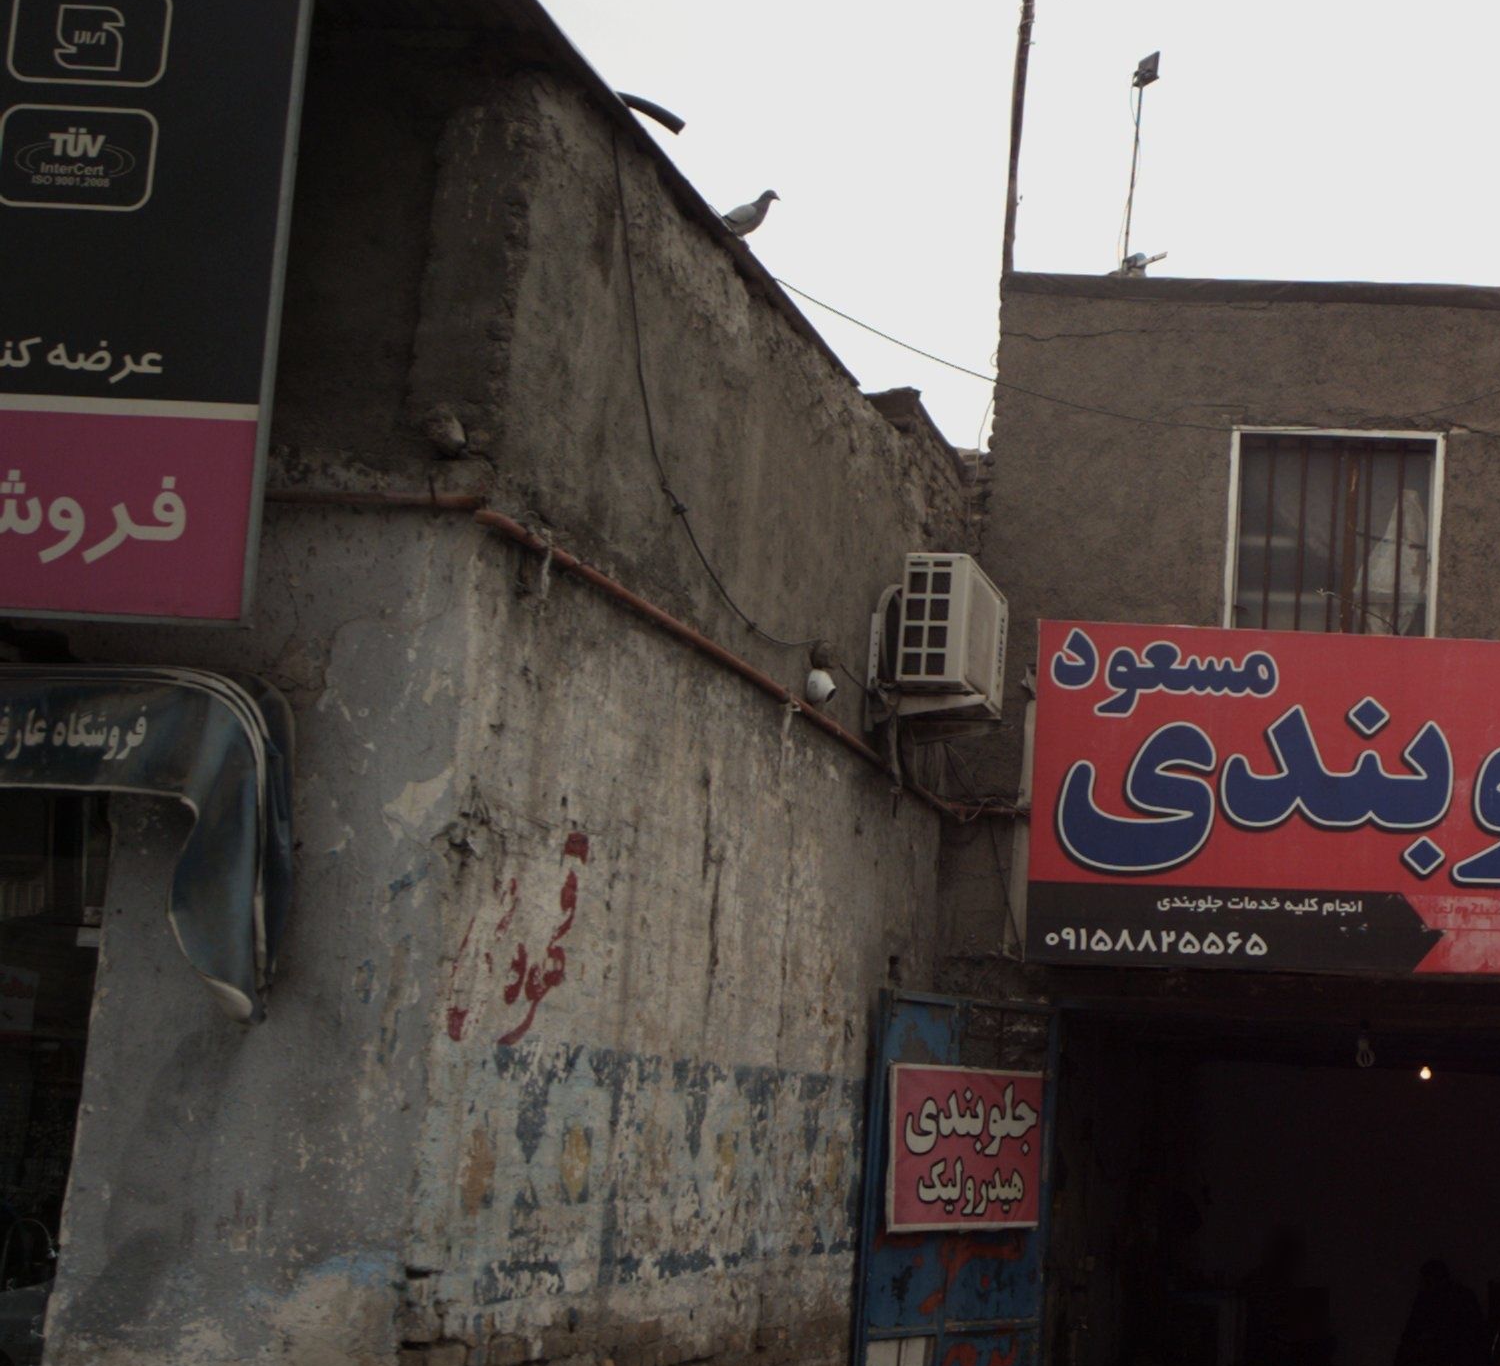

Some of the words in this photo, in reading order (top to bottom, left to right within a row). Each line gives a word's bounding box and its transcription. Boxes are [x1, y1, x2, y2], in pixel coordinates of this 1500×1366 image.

[48, 126, 106, 158] TÜV
[32, 174, 53, 185] ISO
[39, 161, 105, 176] InterCert
[47, 340, 163, 383] عرضه
[1050, 628, 1279, 717] مسعود
[51, 705, 147, 760] فروشگاه
[1156, 895, 1224, 913] جلوبندی
[1226, 896, 1281, 912] خدمات
[1284, 897, 1319, 915] کلیه
[1322, 899, 1363, 916] انجام
[1044, 927, 1269, 956] ۰۹۱۵۸۸۲۵۵۶۵
[904, 1081, 1040, 1157] جلوبندی
[916, 1155, 1025, 1217] هیدرولیک
